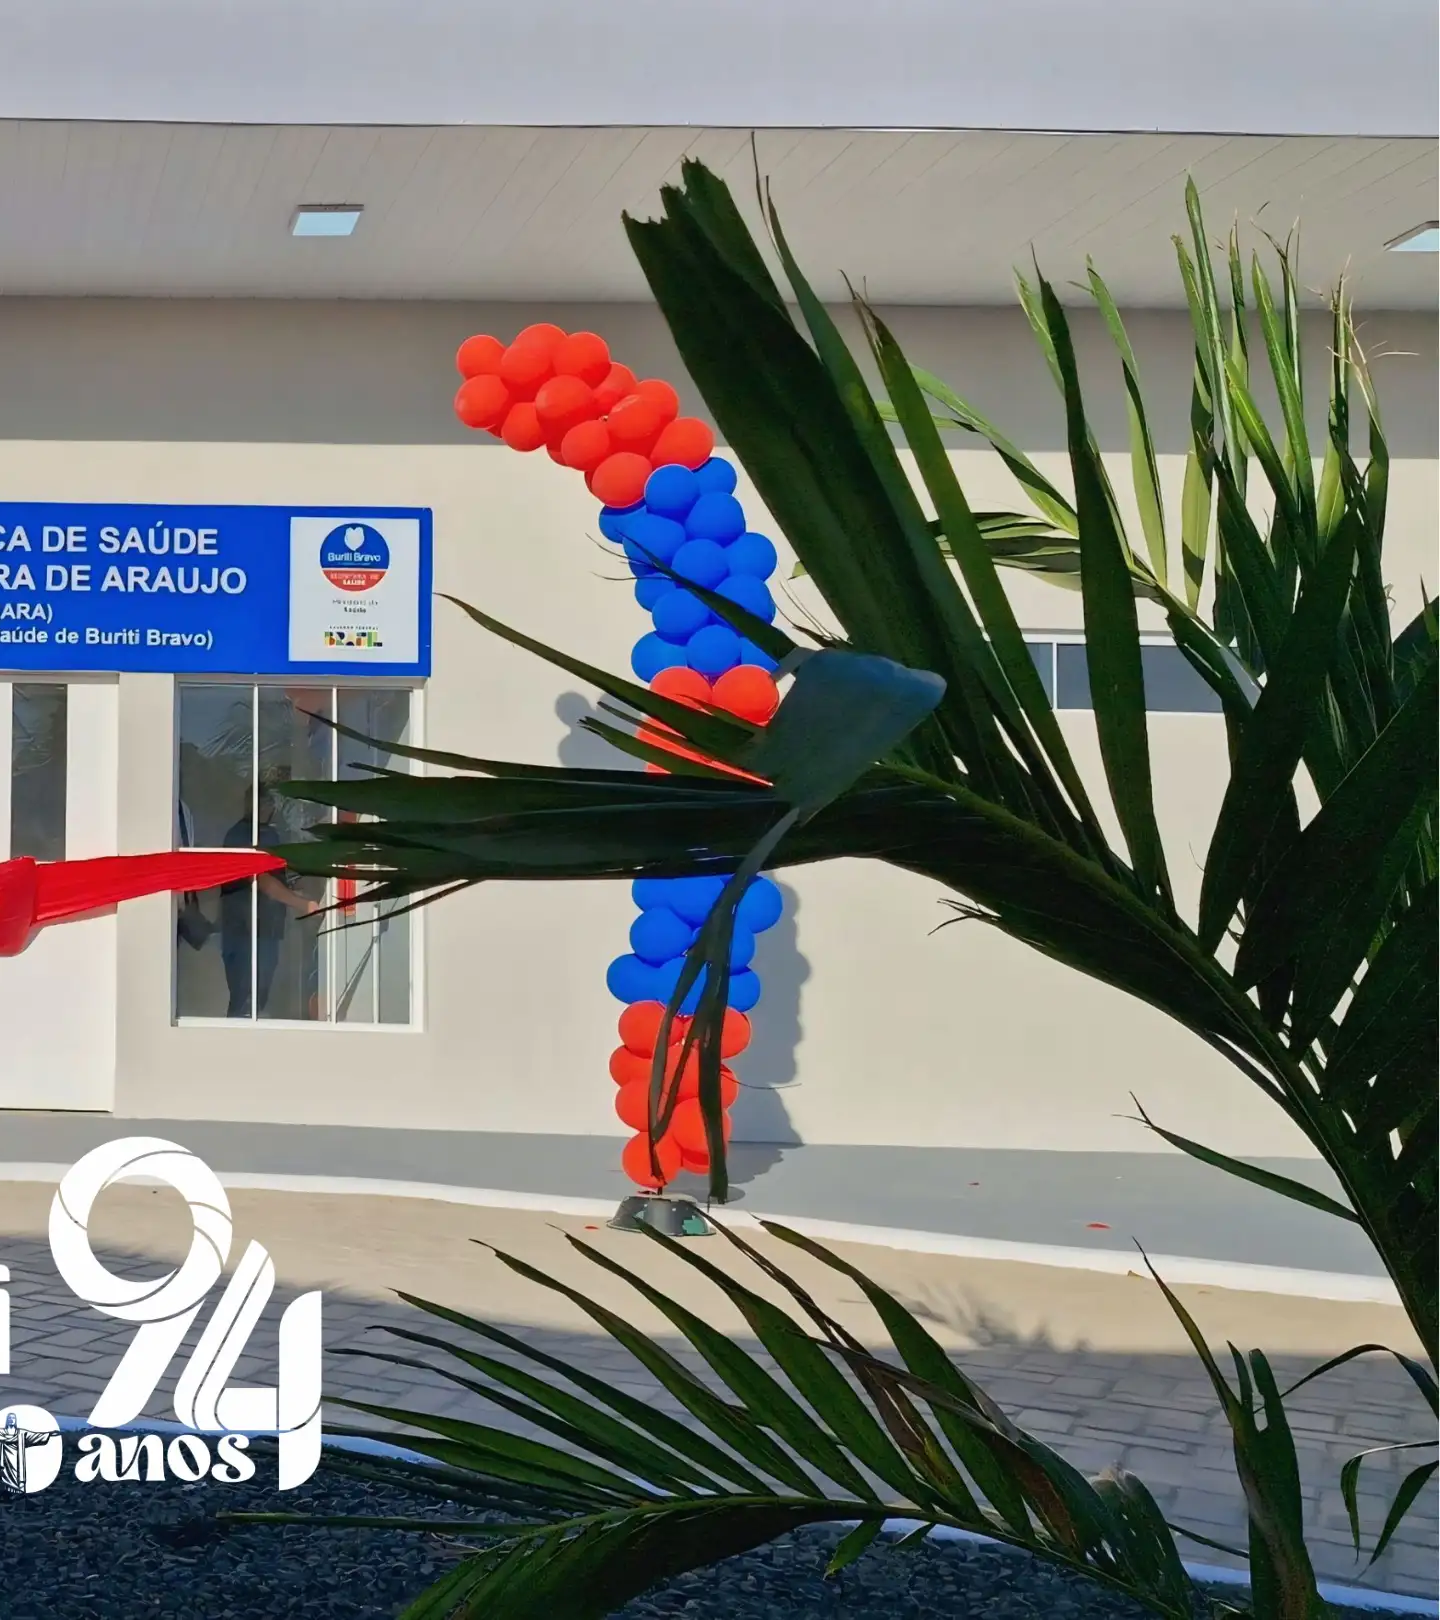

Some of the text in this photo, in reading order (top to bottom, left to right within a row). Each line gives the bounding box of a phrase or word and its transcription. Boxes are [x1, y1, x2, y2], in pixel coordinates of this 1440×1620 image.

[42, 526, 88, 553] DE
[98, 521, 218, 556] SAÚDE
[45, 565, 91, 591] DE
[101, 566, 247, 594] ARAUJO
[55, 627, 79, 644] de
[86, 628, 140, 645] Buriti
[146, 629, 214, 650] Bravo)
